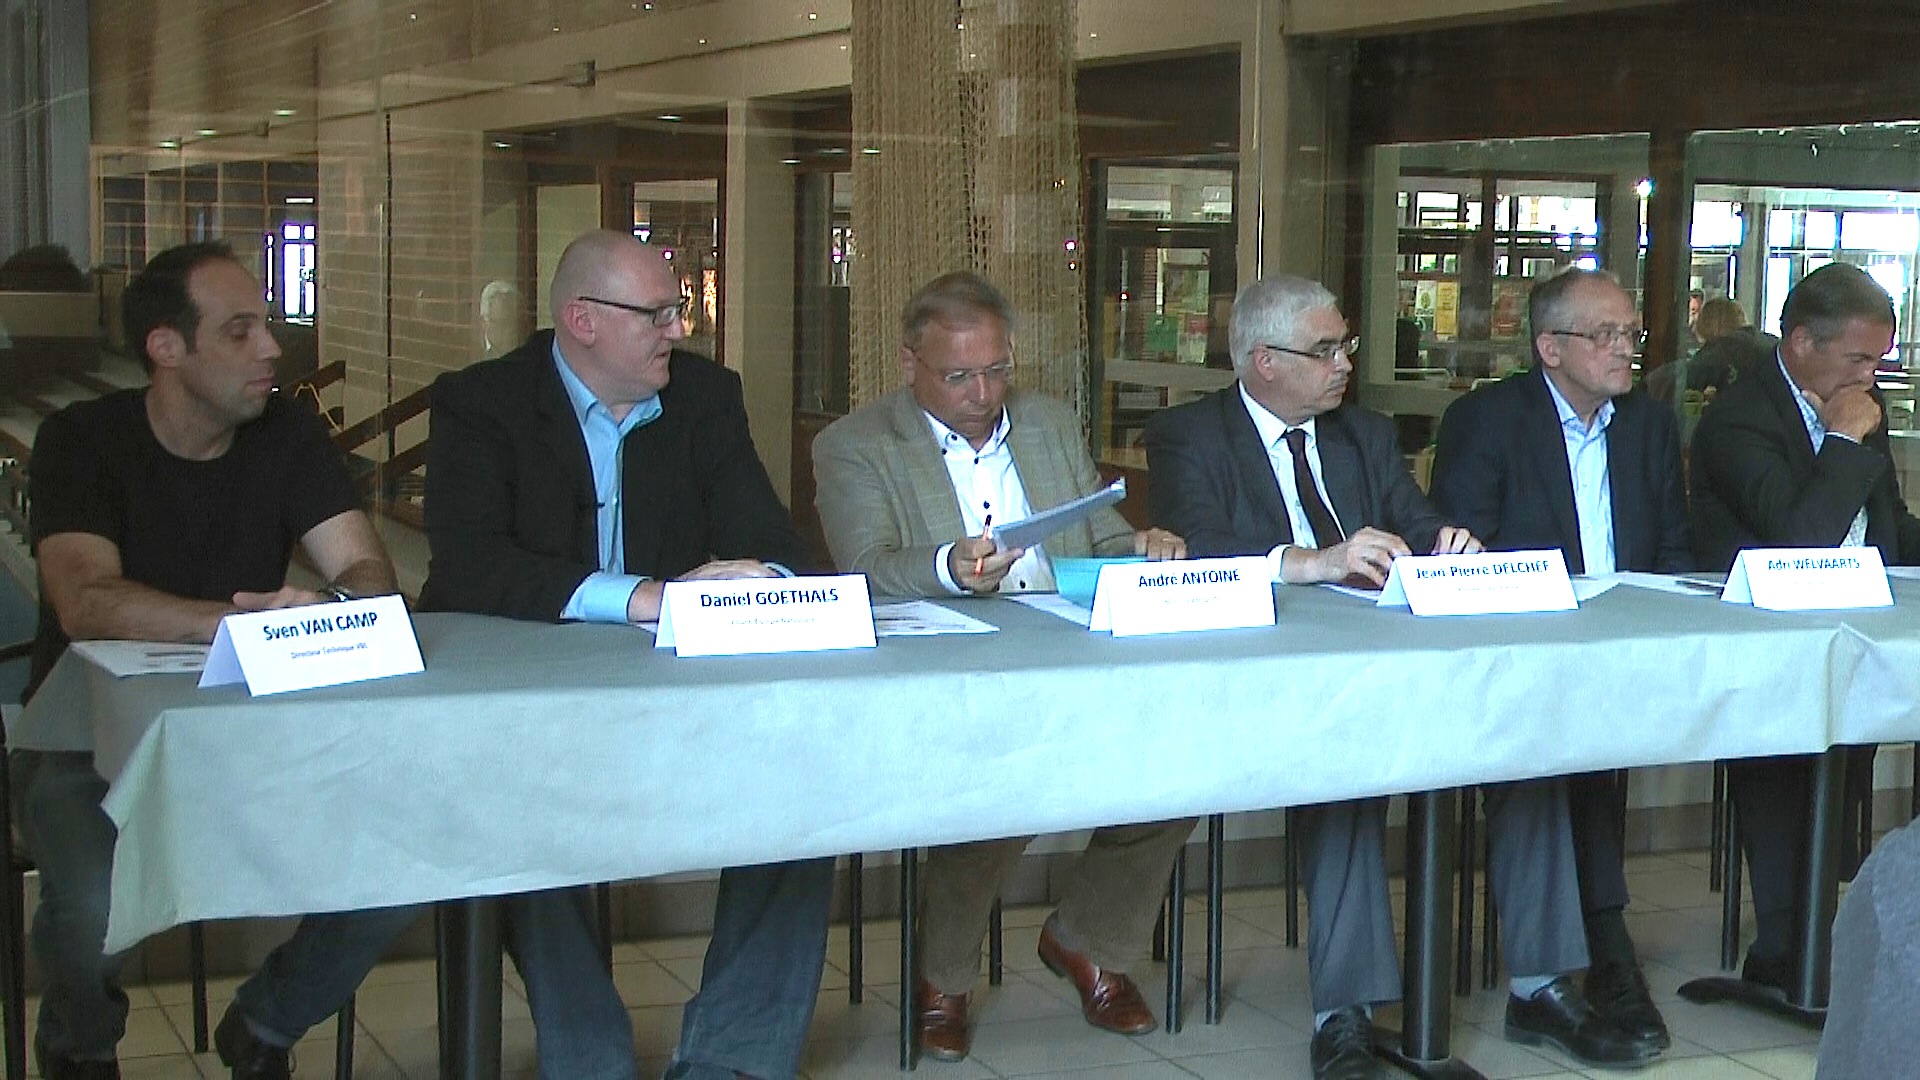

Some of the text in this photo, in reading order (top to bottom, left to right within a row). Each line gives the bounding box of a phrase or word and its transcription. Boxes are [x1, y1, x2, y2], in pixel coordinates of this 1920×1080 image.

[1416, 560, 1549, 579] Jean-Pierre DELCHEF
[1793, 558, 1860, 569] WELVAARTS
[1138, 569, 1240, 587] André ANTOINE
[700, 588, 839, 607] Daniel GOETHALS
[263, 611, 378, 641] Sven VAN CAMP
